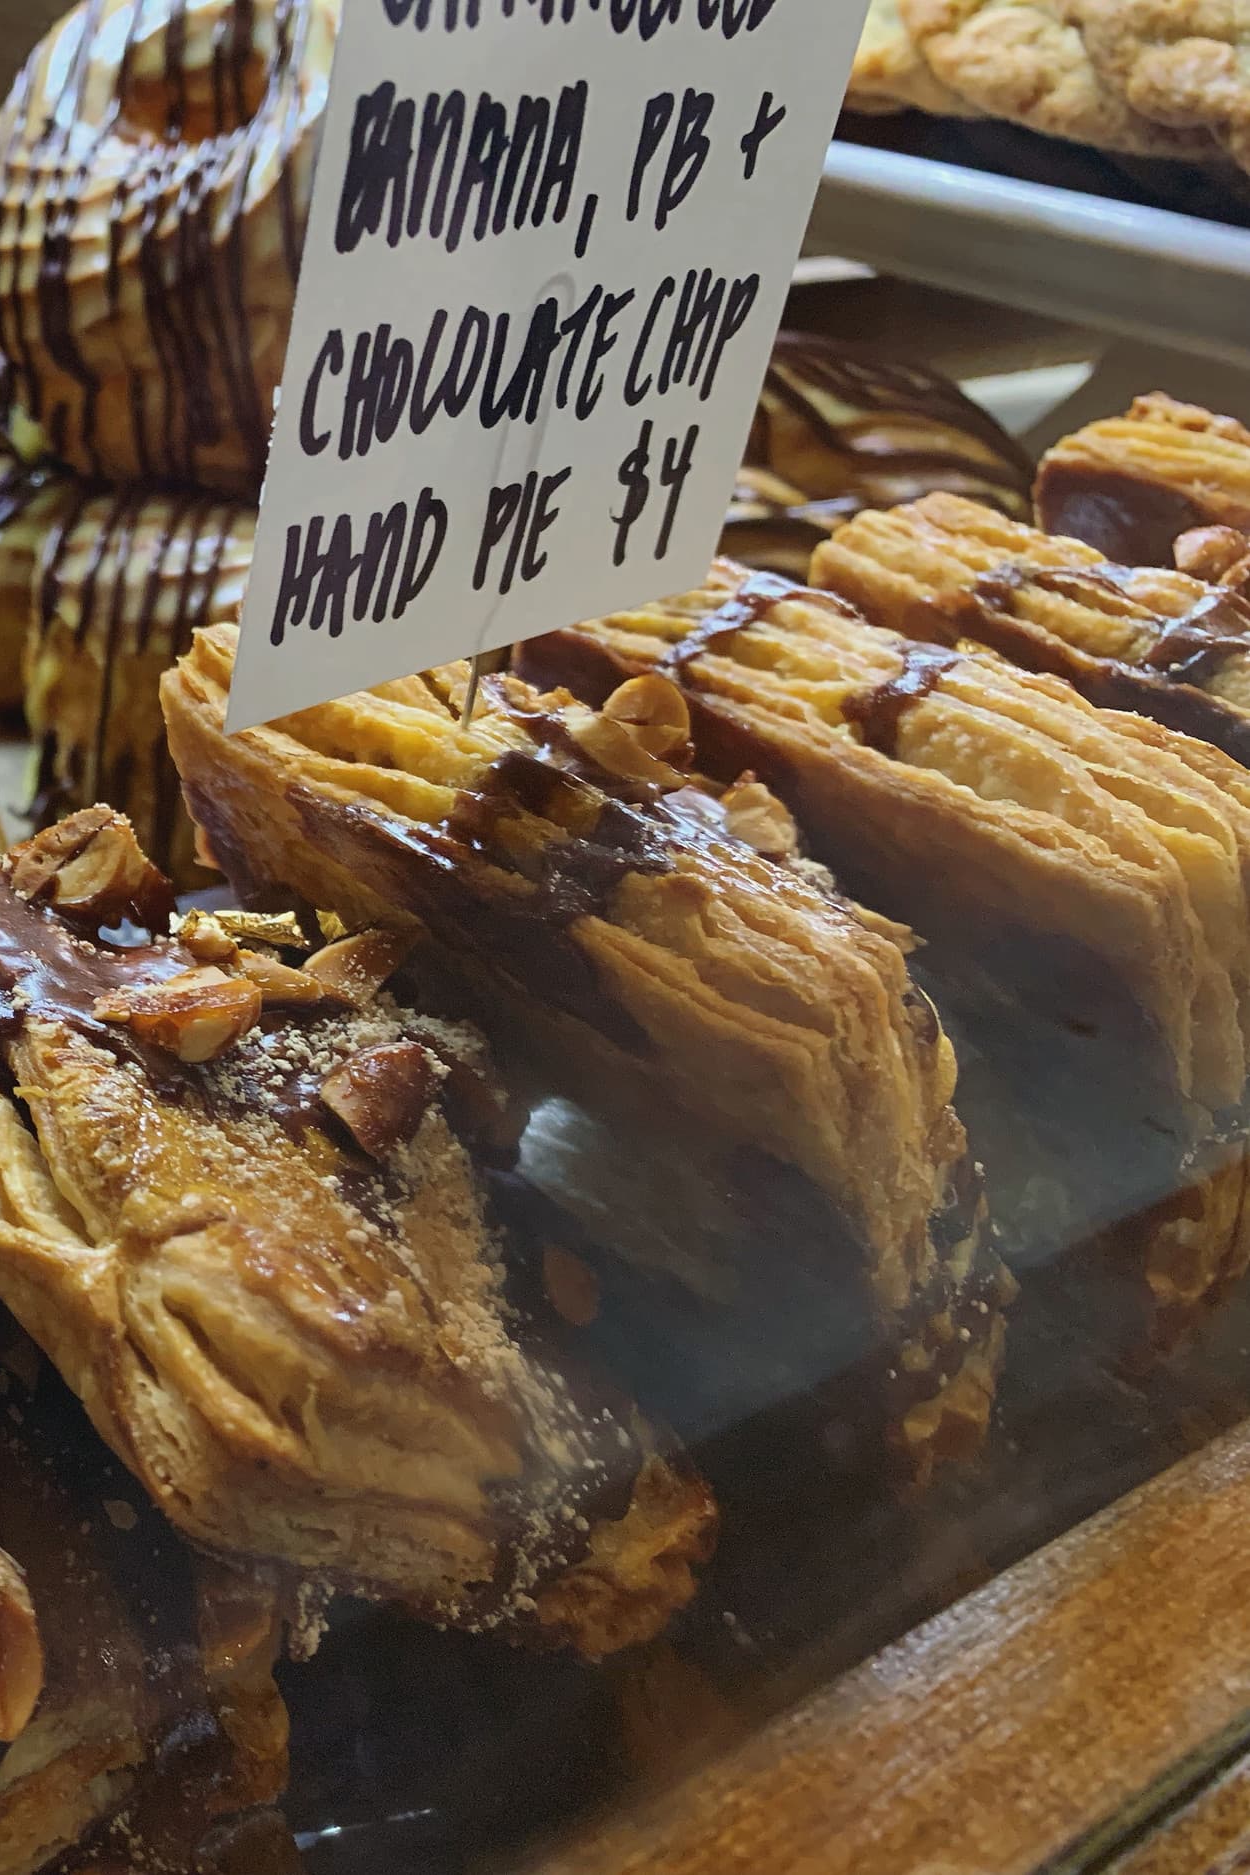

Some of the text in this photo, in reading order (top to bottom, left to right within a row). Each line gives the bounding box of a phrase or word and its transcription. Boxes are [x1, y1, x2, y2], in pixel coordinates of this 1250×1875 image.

[334, 79, 787, 259] BANANA, PB +
[298, 267, 761, 461] CHOCOLATE CHIP
[269, 419, 700, 647] HAND PIE $4
